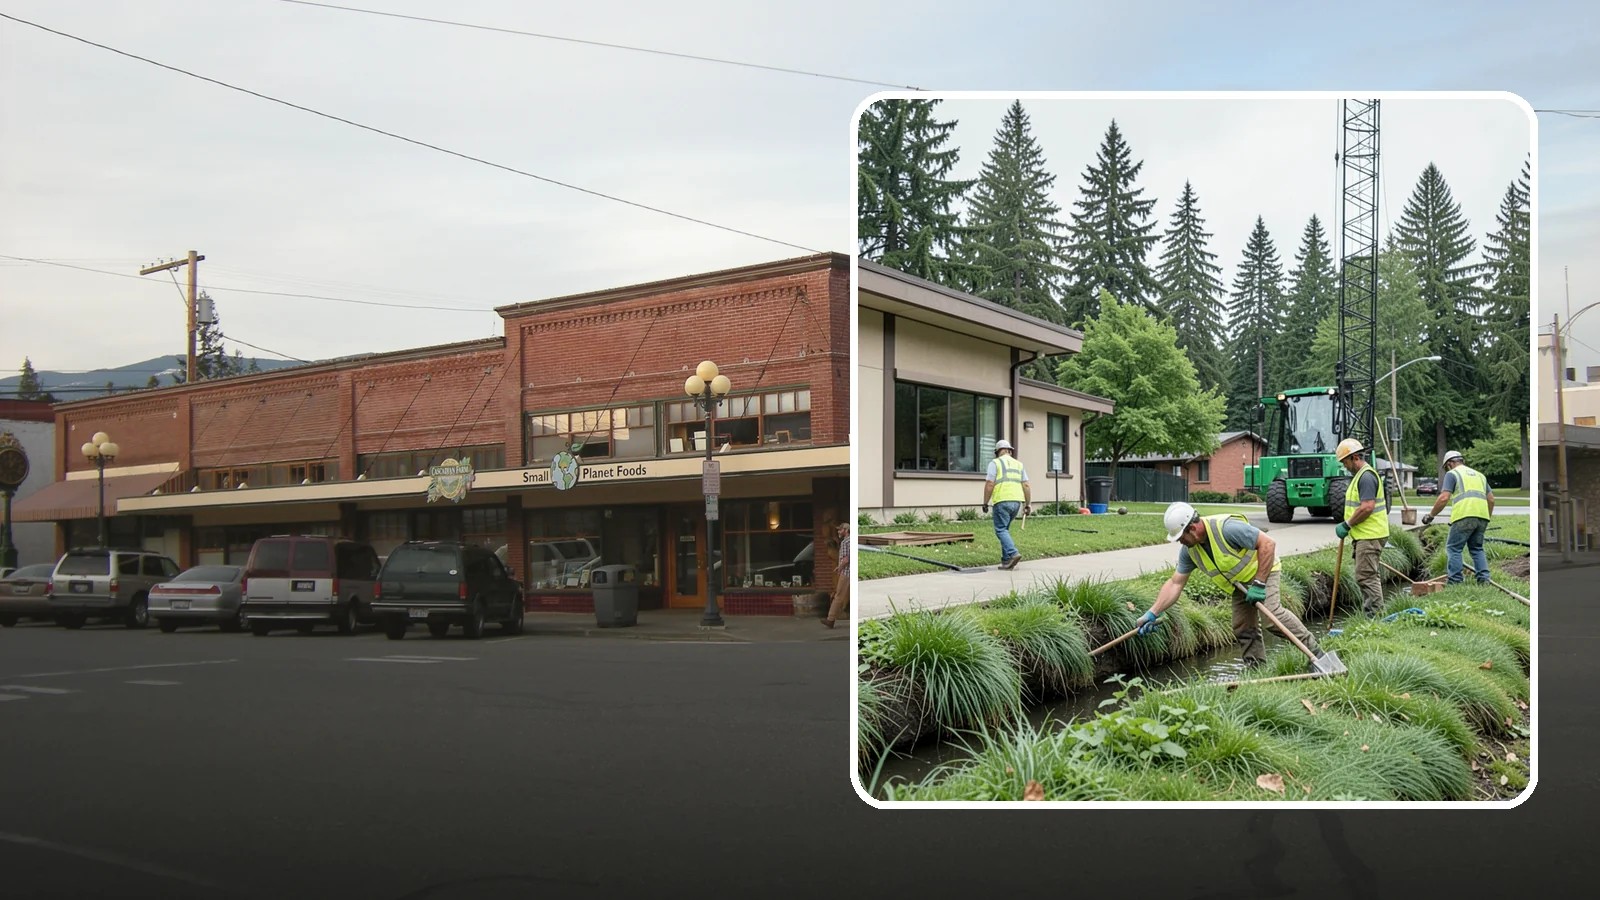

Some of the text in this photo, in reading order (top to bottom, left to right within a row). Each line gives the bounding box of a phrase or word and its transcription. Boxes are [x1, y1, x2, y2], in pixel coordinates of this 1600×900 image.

[523, 464, 647, 482] Small Planet Foods
